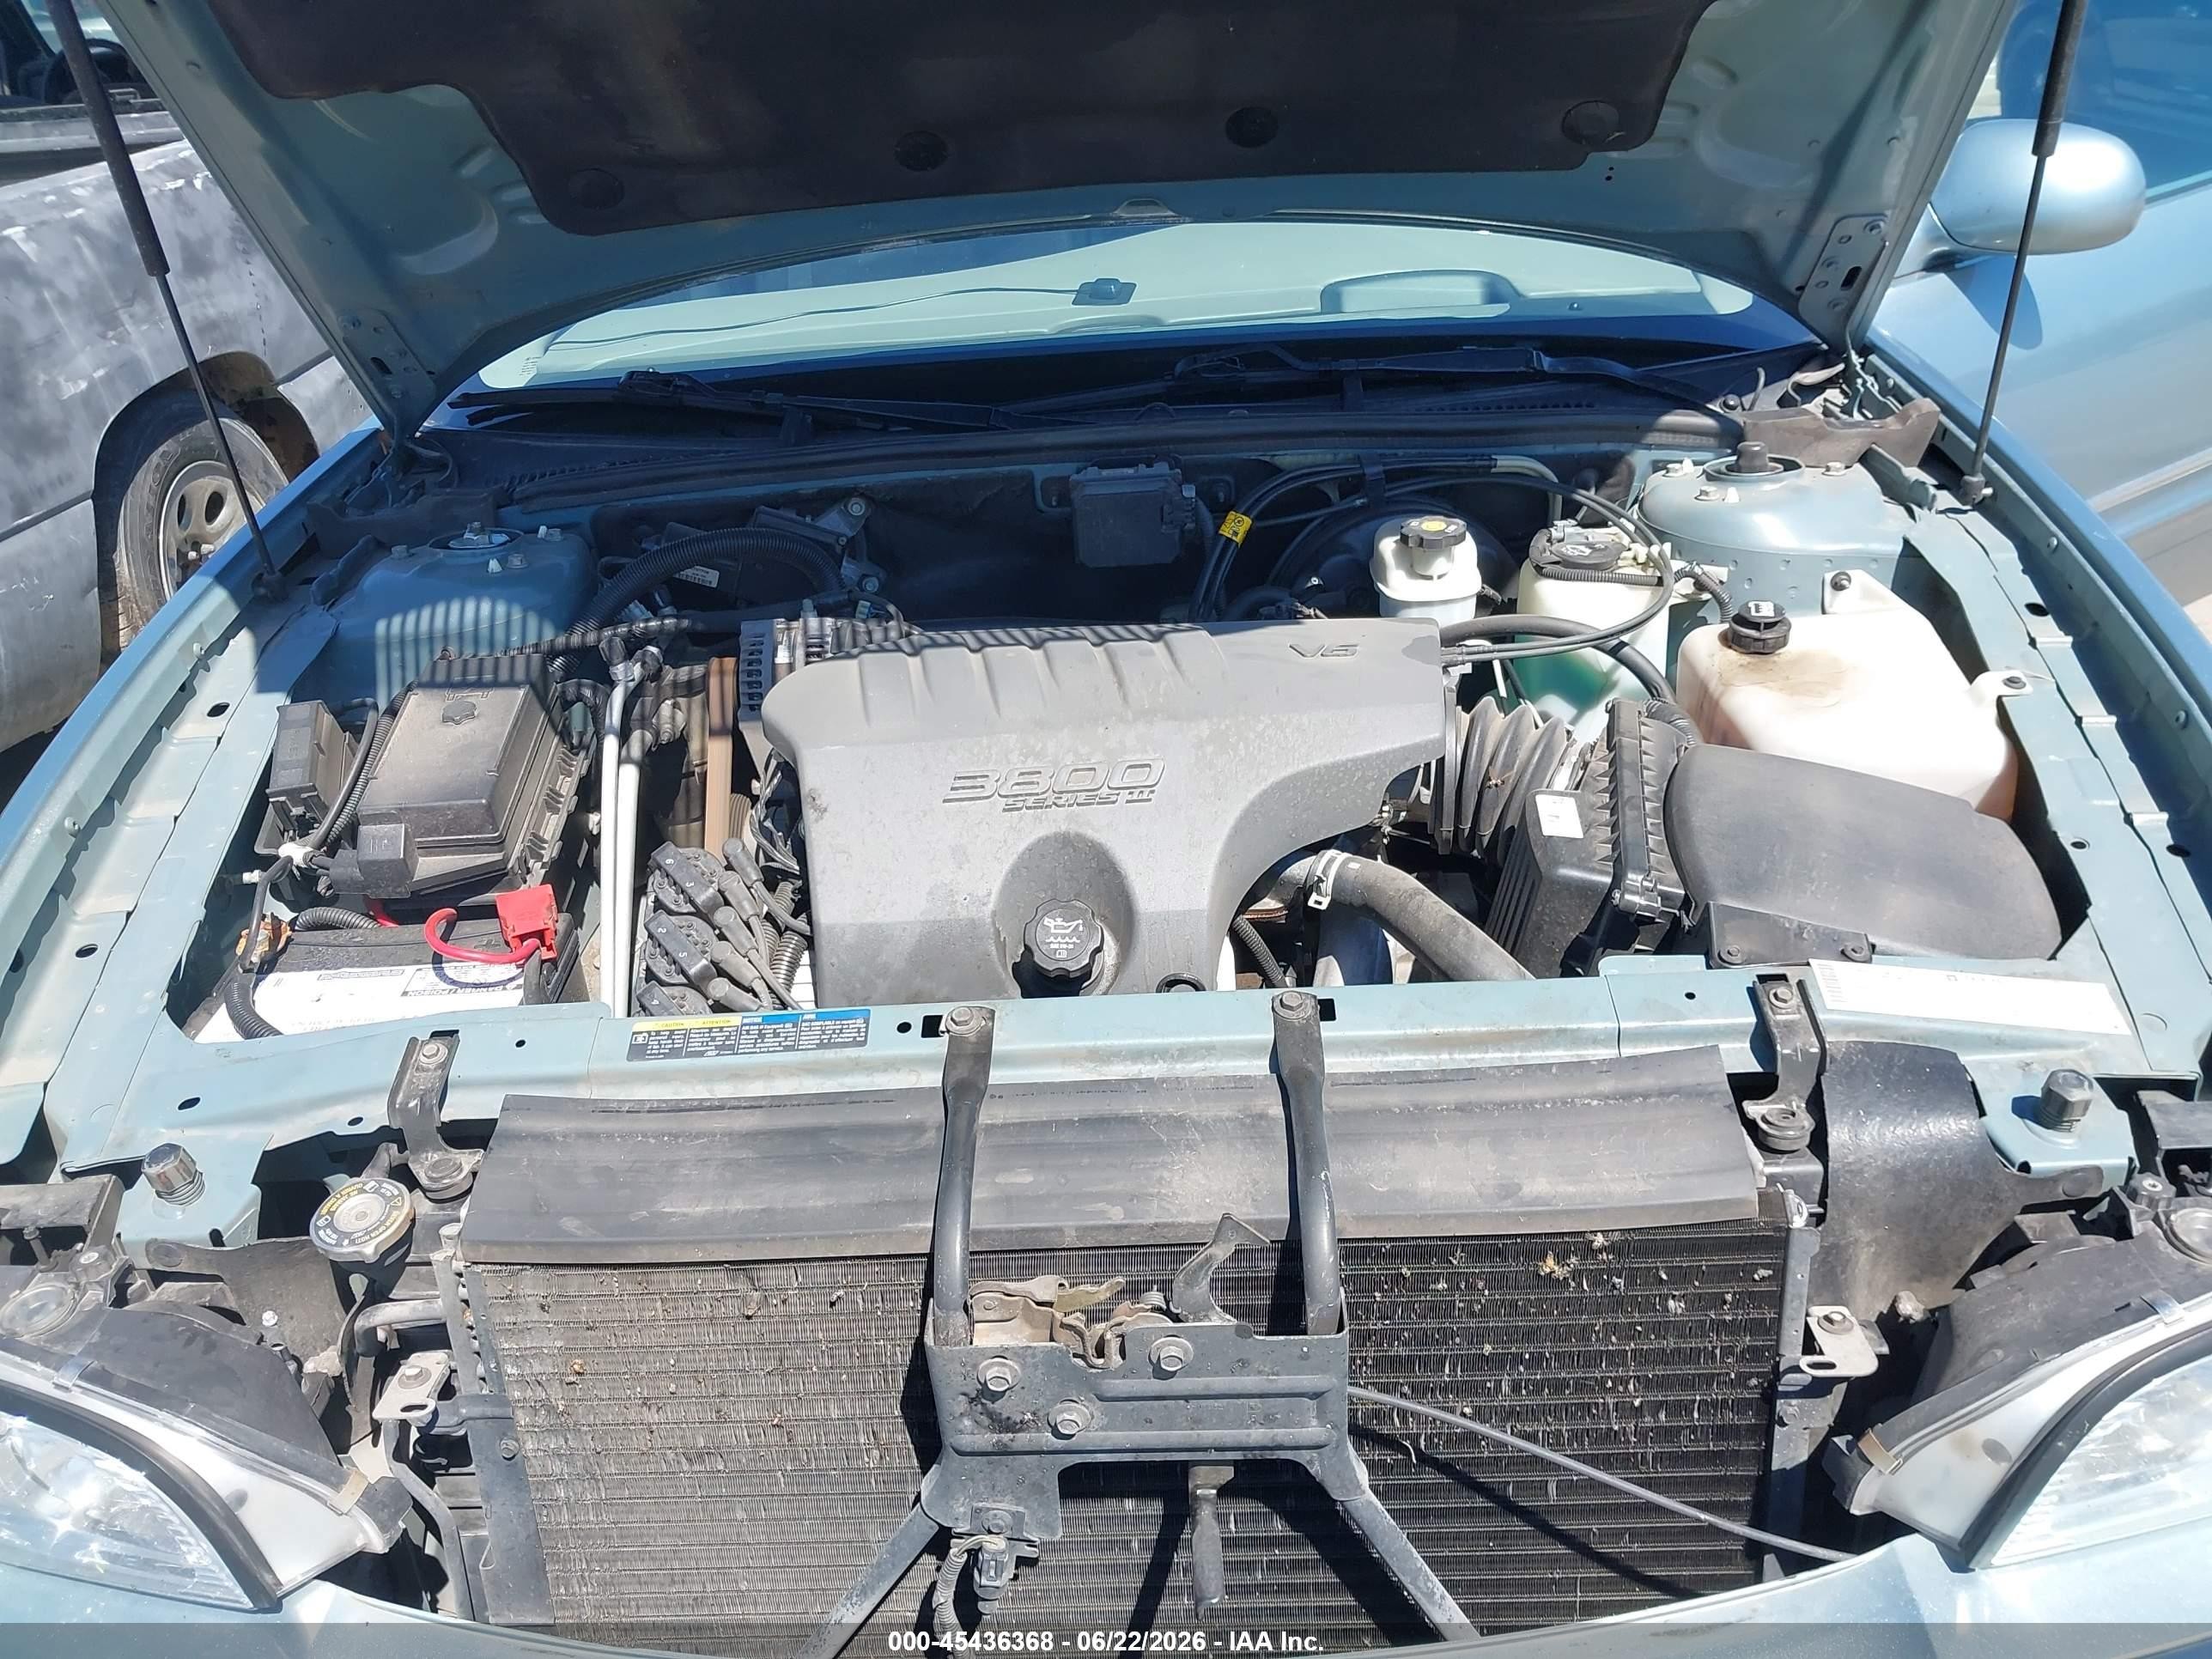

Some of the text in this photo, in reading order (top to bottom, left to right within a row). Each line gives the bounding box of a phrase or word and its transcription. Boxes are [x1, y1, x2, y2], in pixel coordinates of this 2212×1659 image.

[1288, 642, 1360, 659] V6
[942, 757, 1165, 804] 3800
[1001, 791, 1121, 813] SERIES
